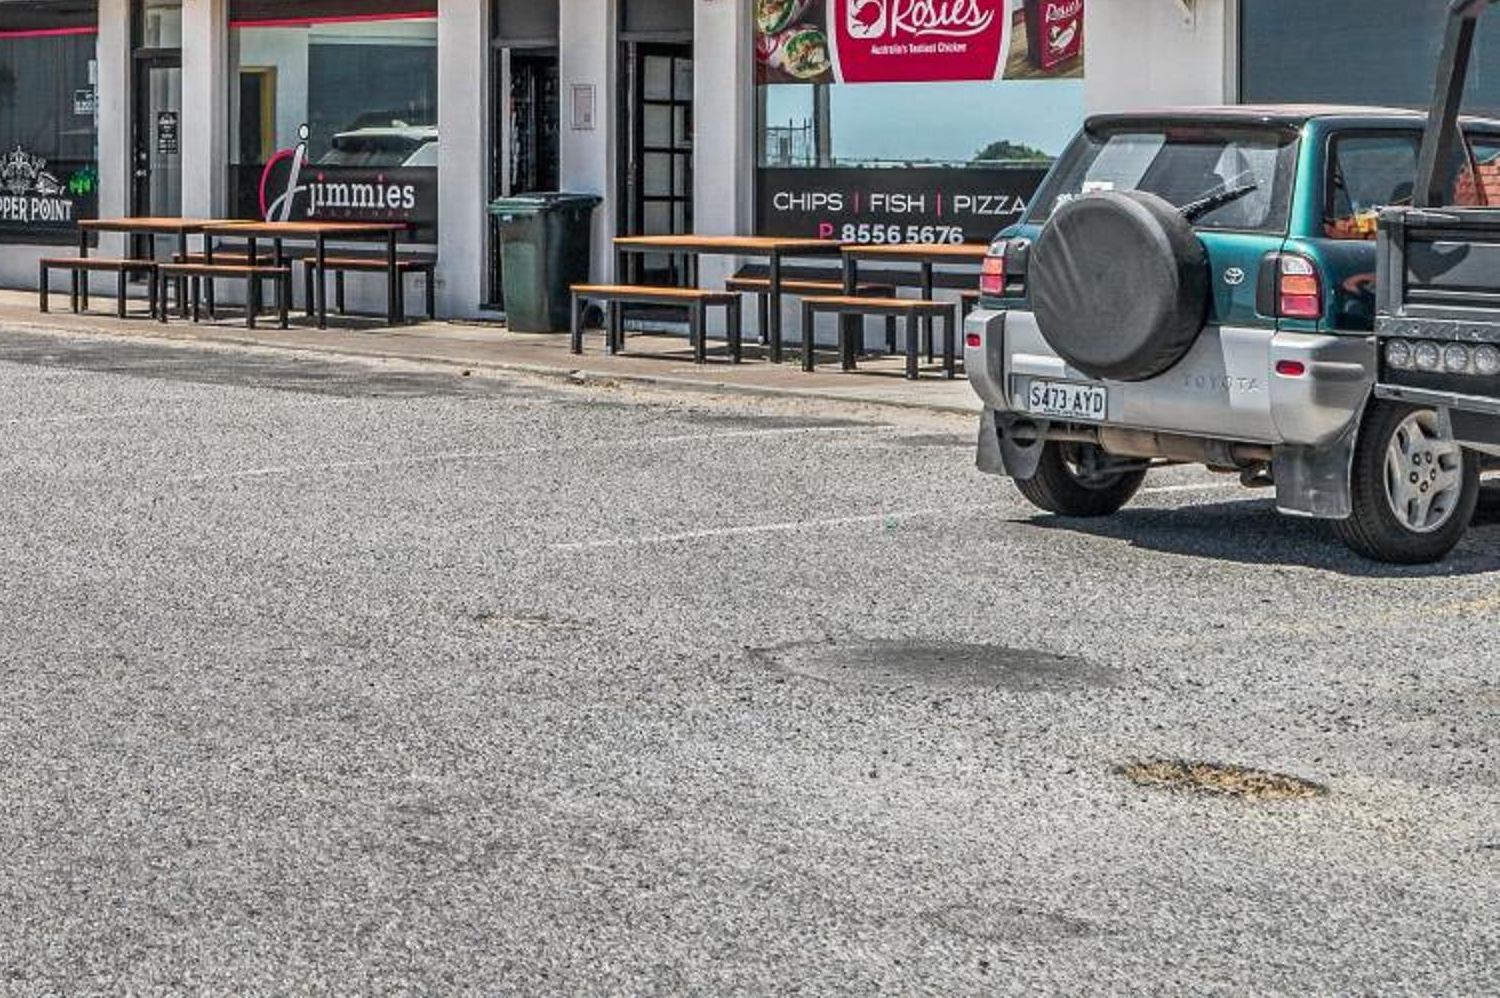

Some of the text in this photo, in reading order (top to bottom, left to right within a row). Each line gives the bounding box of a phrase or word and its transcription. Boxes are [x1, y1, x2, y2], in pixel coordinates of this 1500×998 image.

[307, 172, 415, 216] jimmies
[773, 192, 1027, 215] CHIPS FISH PIZZA
[31, 198, 73, 221] POINT
[818, 223, 964, 245] P 8556 5676
[1183, 373, 1259, 393] TOYOTA
